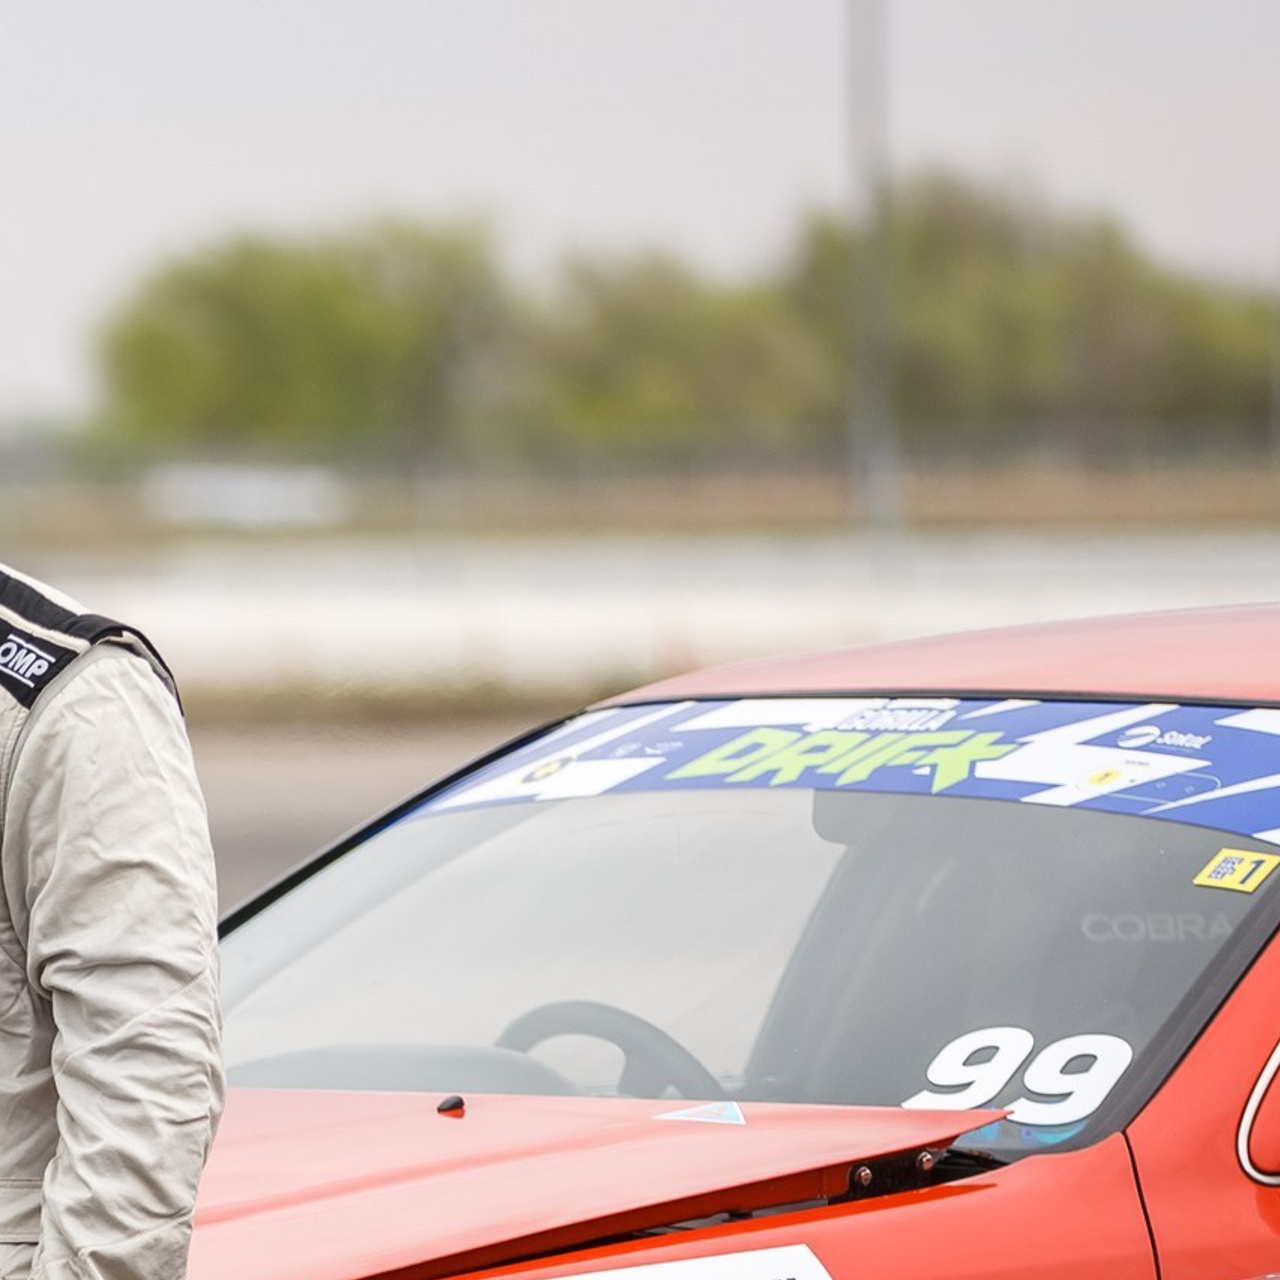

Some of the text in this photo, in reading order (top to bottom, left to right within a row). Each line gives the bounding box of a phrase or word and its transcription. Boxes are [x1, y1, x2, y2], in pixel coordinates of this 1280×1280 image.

[664, 727, 1020, 794] DRIFT
[1238, 859, 1266, 885] 1
[1081, 911, 1234, 943] COBRA
[901, 1026, 1134, 1127] 99
